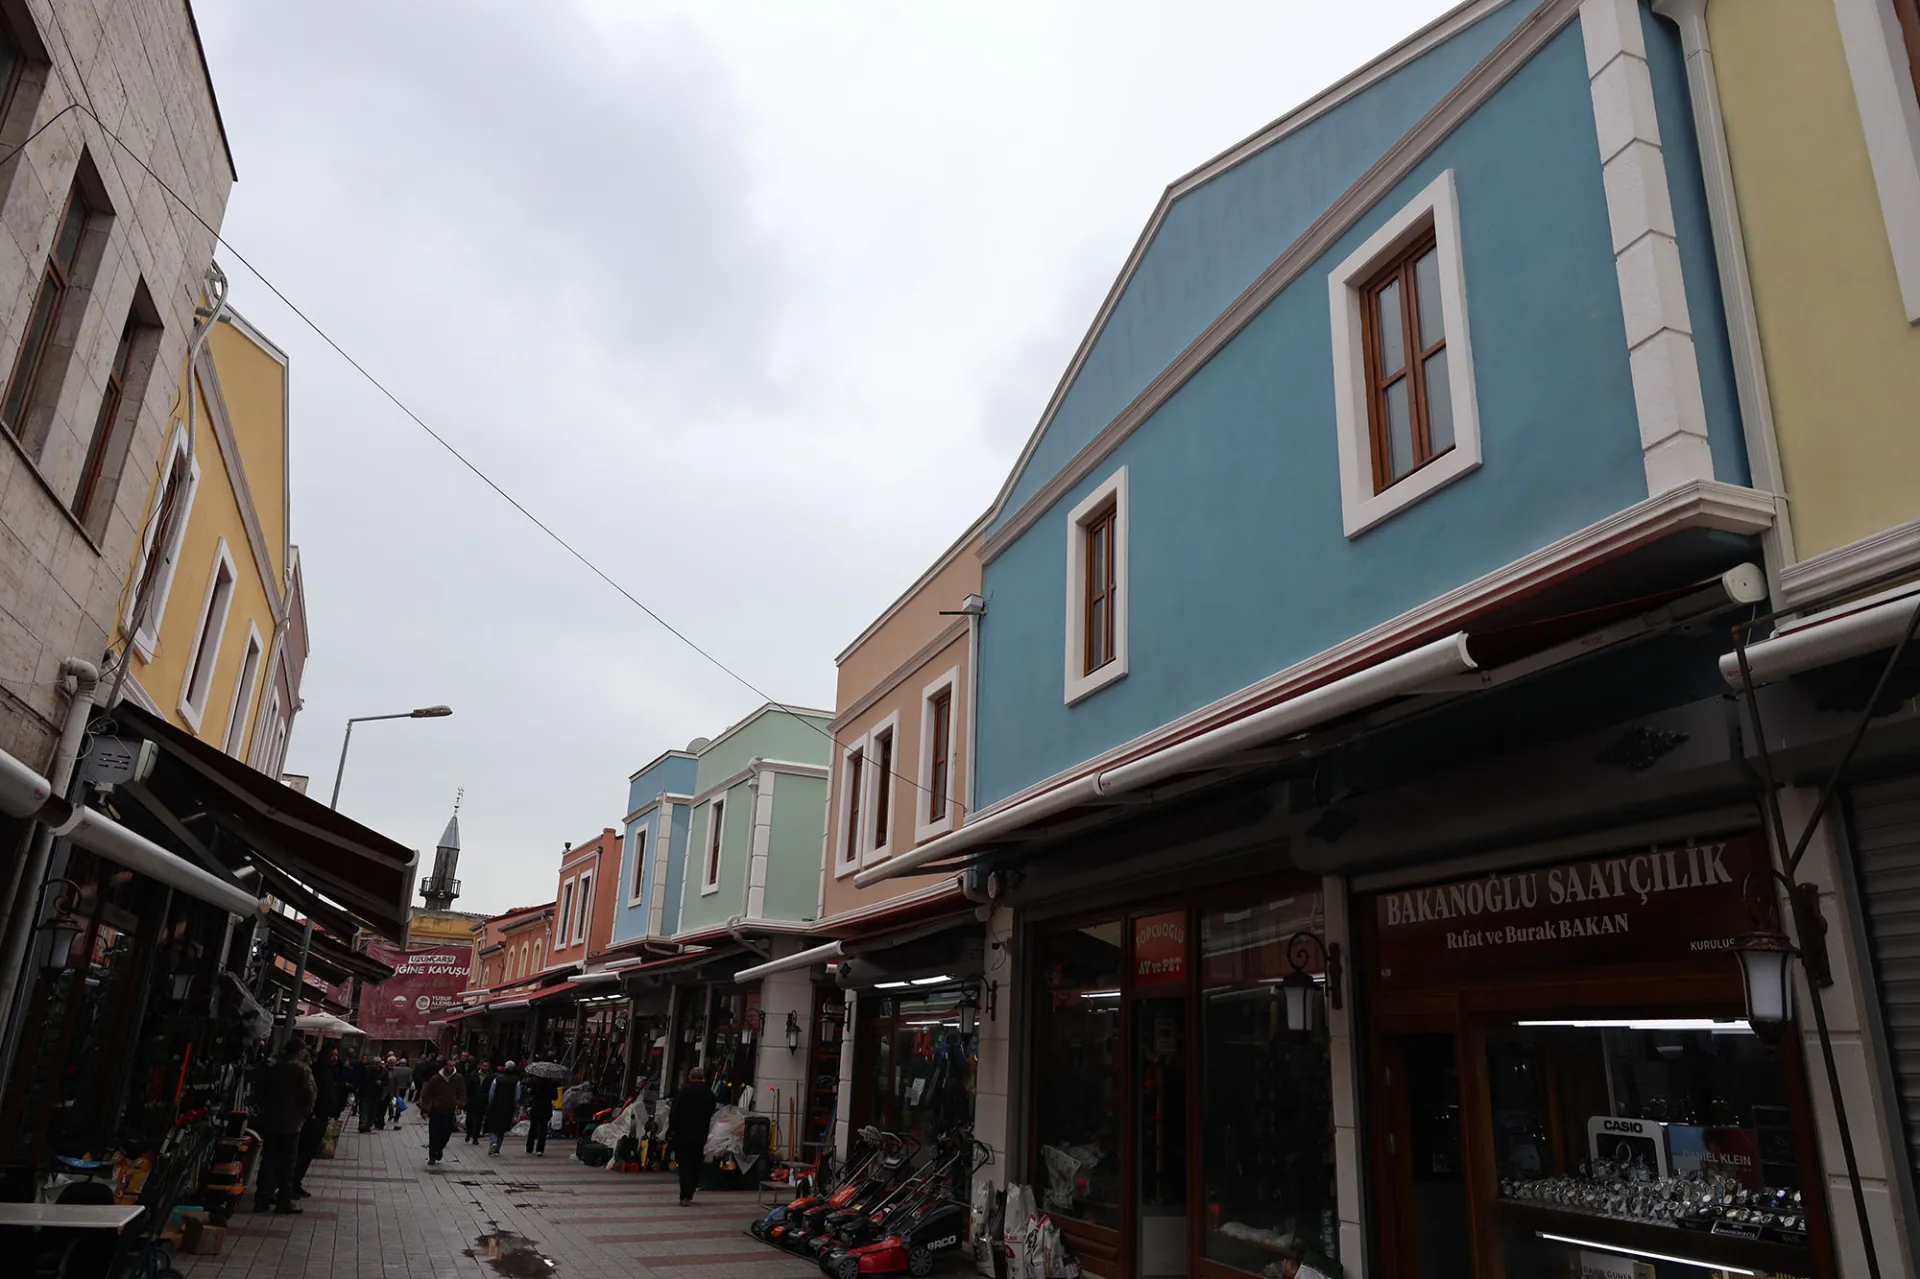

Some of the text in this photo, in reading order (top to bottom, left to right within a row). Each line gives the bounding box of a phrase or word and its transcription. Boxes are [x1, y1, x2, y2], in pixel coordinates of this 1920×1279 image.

[1385, 838, 1733, 926] BAKANOĞLU SAATÇİLİK
[1446, 913, 1629, 949] Rıfat ve Burak BAKAN
[1162, 957, 1182, 973] PET
[1603, 1120, 1643, 1134] CASIO
[1719, 1153, 1751, 1166] KLEIN
